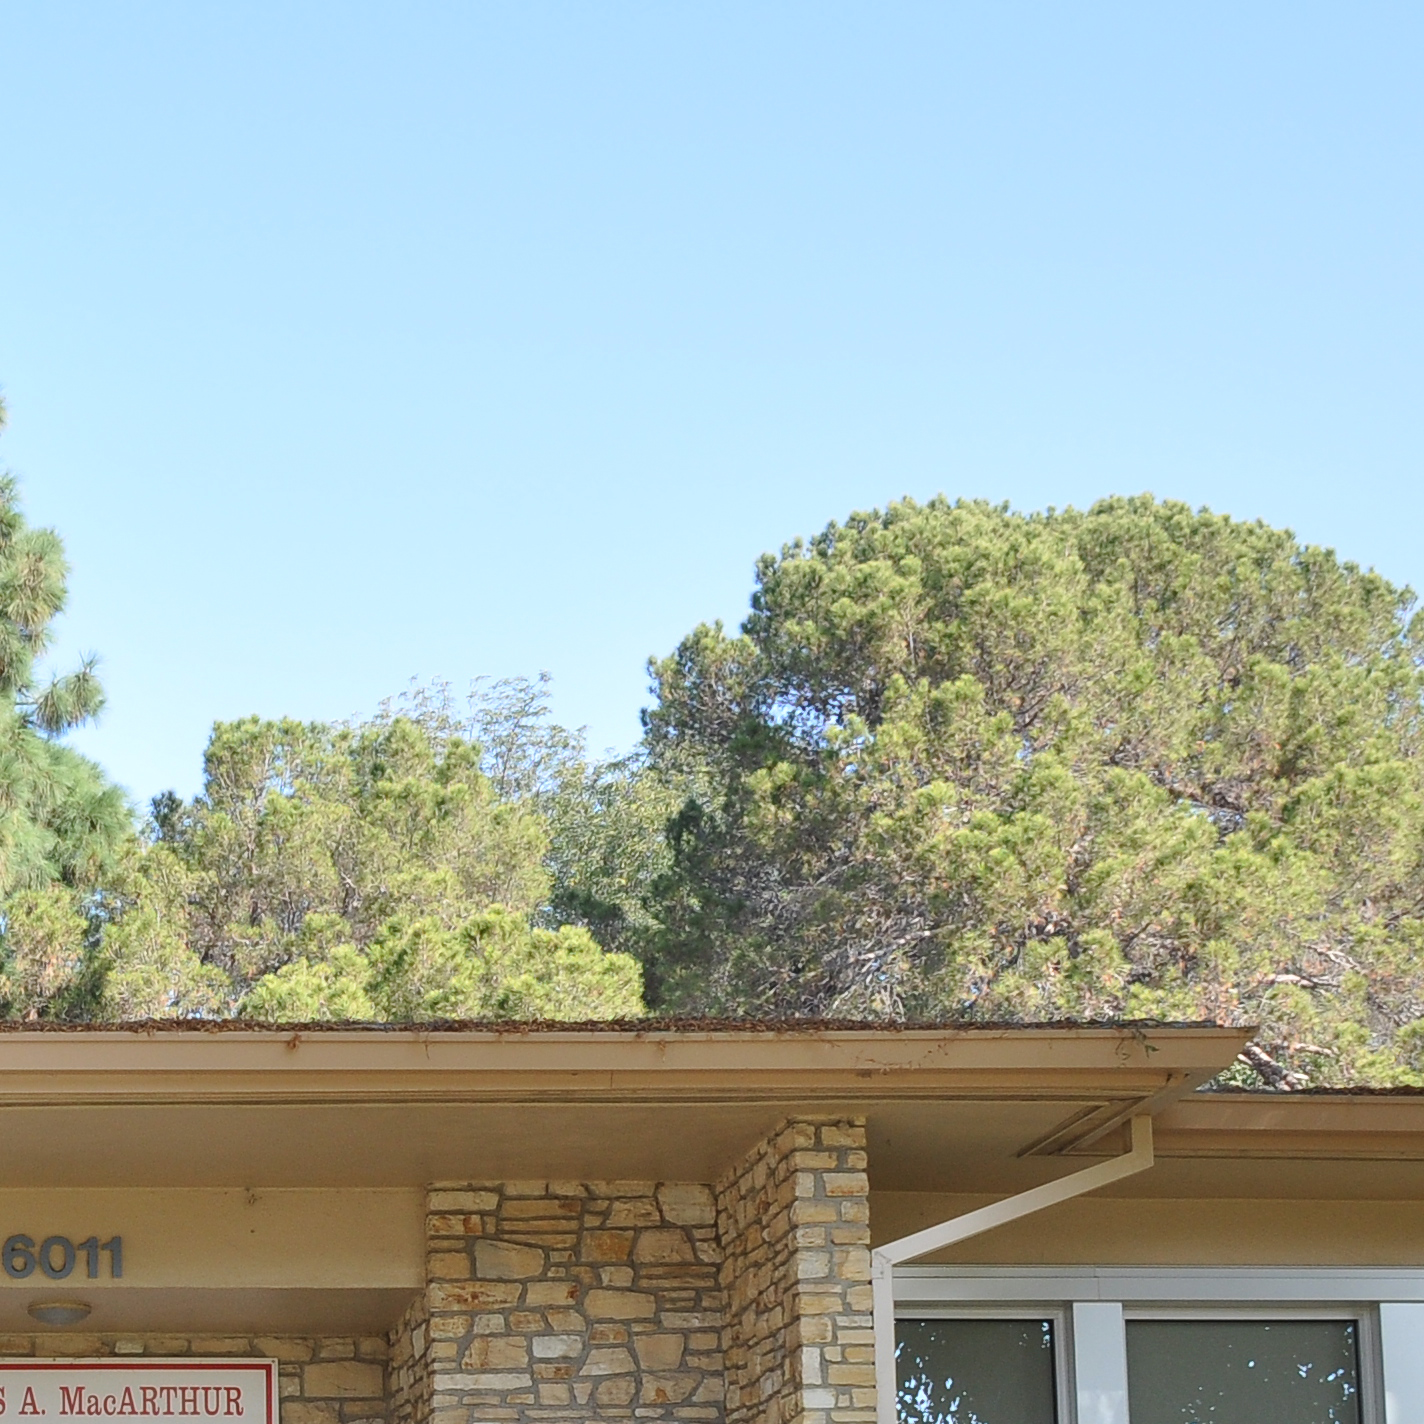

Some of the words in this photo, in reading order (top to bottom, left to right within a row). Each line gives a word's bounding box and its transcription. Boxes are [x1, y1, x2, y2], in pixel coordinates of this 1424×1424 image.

[2, 1234, 124, 1279] 6011
[19, 1386, 46, 1416] A.
[59, 1386, 245, 1417] MacARTHUR
